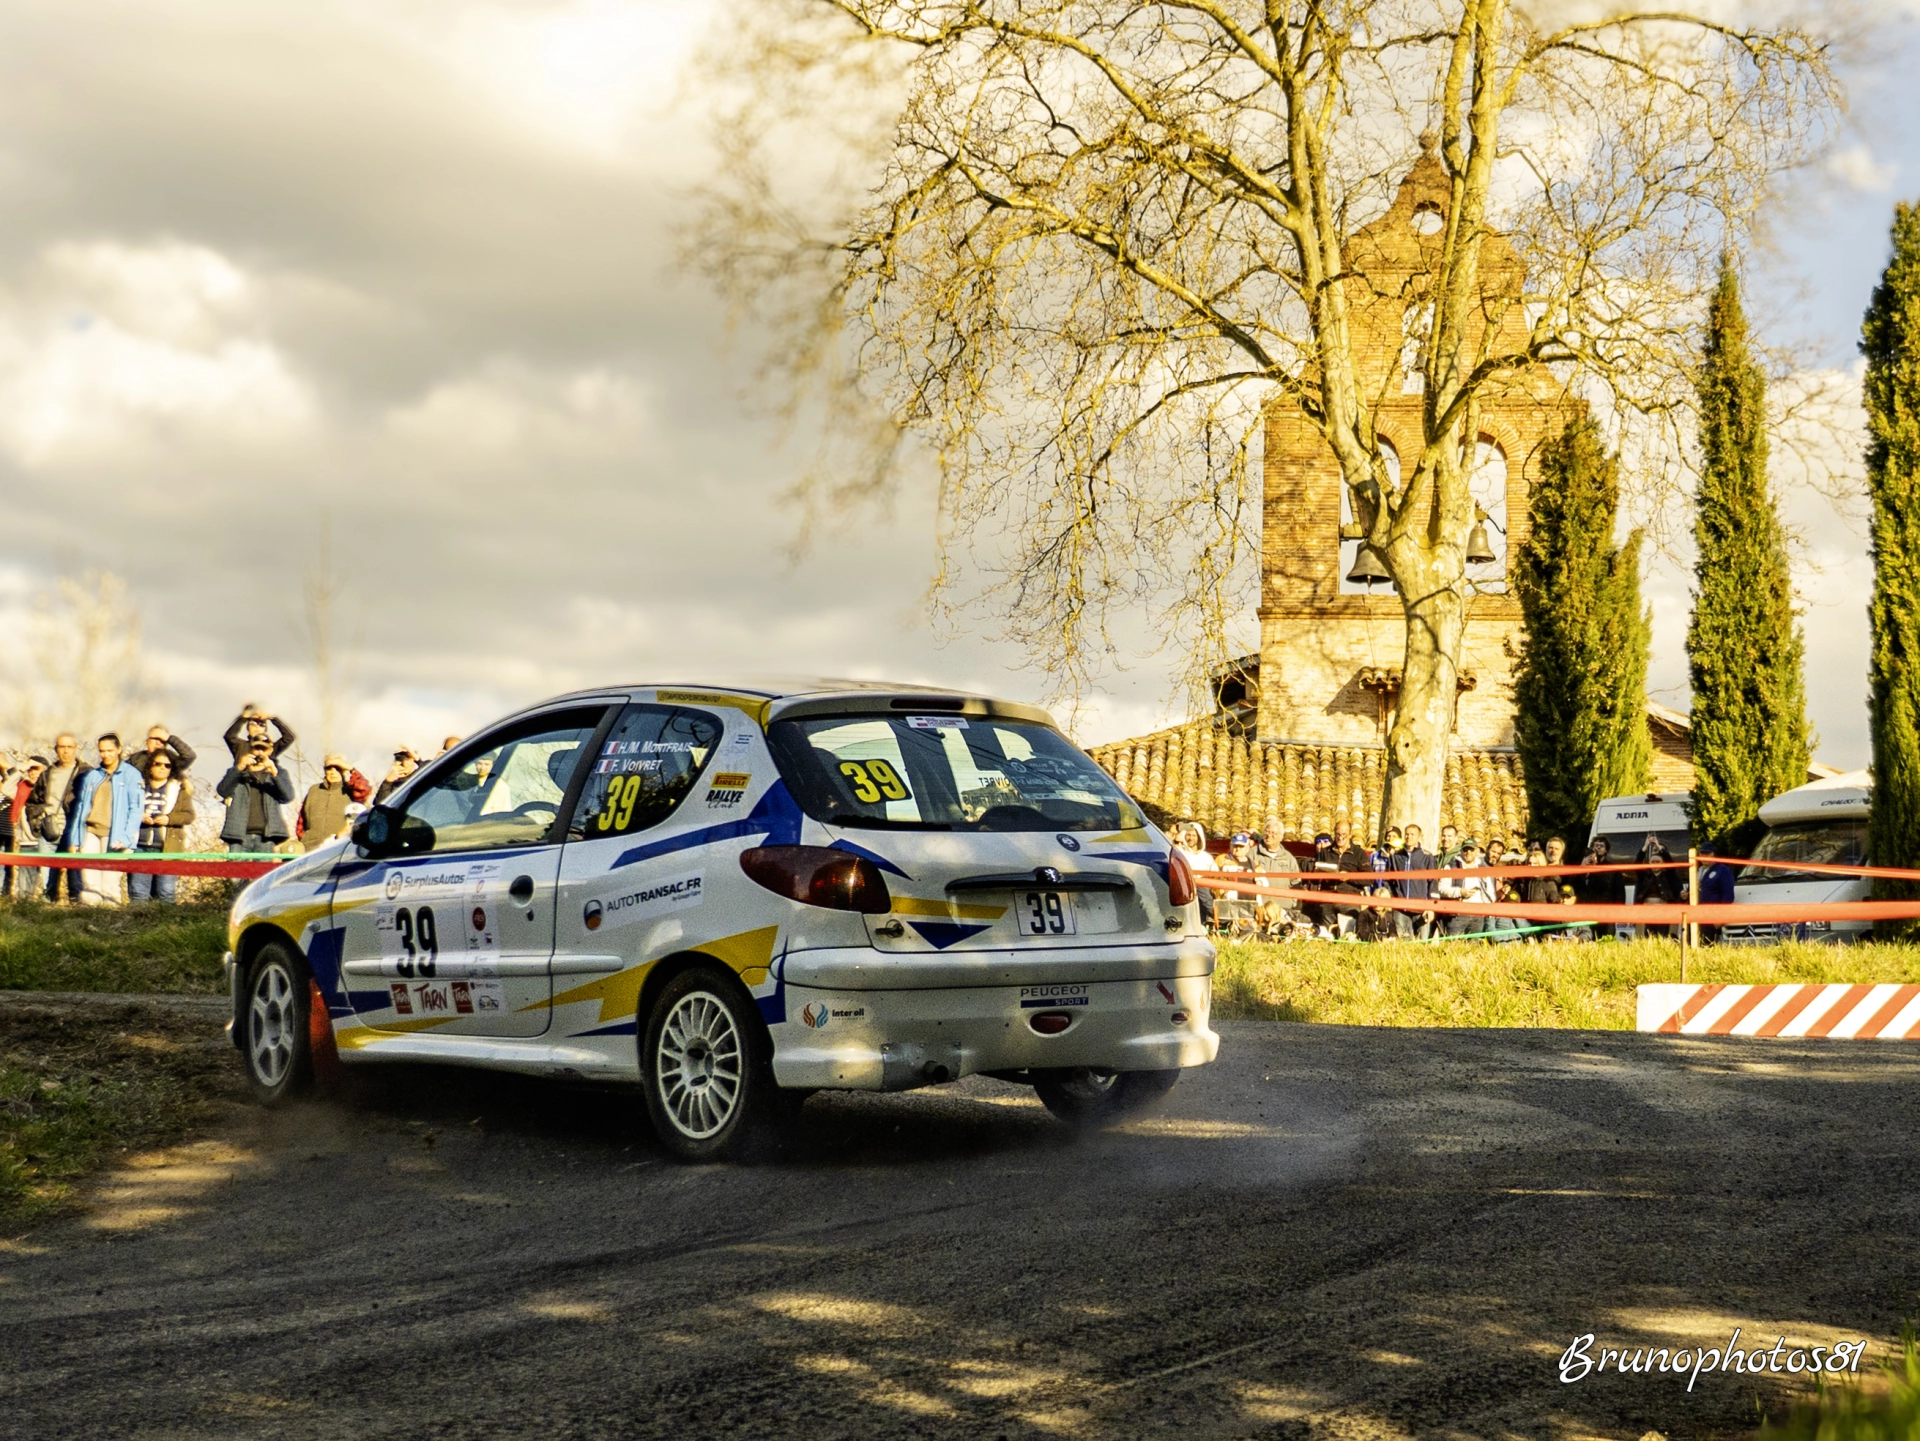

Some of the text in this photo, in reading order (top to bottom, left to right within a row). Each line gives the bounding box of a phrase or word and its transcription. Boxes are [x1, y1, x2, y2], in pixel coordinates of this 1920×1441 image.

[621, 759, 663, 772] VOIVRET
[714, 775, 748, 786] PIRELLI
[840, 760, 907, 803] 39
[598, 775, 641, 831] 39
[705, 789, 745, 803] RALLYE
[1616, 811, 1649, 819] ADRIA
[404, 873, 466, 889] SurplusAutos
[607, 877, 702, 912] AUTOTRANSAC.FR
[1026, 892, 1065, 934] 39
[396, 905, 438, 978] 39
[413, 982, 448, 1013] TARN
[1020, 985, 1089, 997] PEUGEOT
[1055, 998, 1087, 1006] SPORT
[832, 1007, 865, 1017] inter oil
